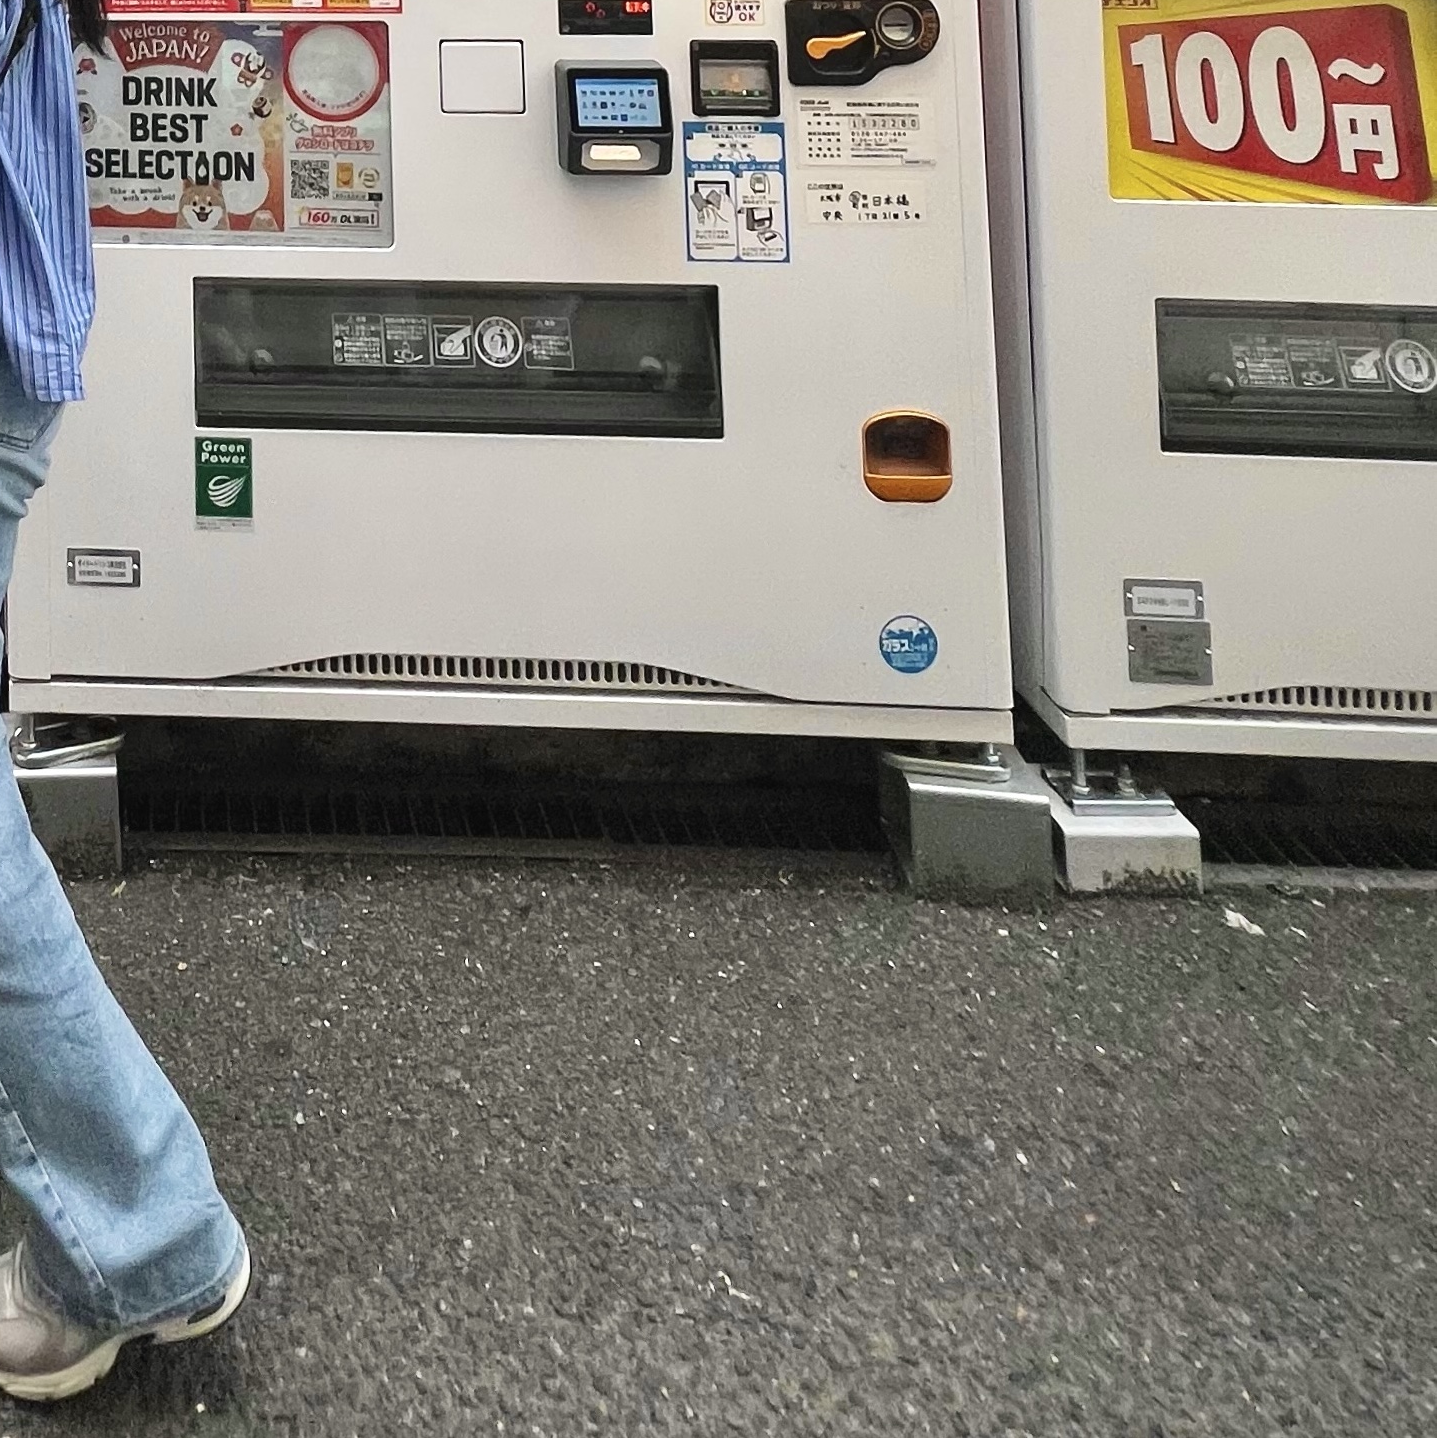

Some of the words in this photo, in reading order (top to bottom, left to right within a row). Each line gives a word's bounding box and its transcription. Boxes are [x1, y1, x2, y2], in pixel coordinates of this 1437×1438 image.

[738, 13, 756, 22] OK
[118, 23, 188, 42] Welcome
[192, 26, 211, 42] to
[124, 38, 210, 64] JAPAN!
[122, 75, 218, 108] DRINK
[129, 112, 209, 144] BEST
[202, 440, 245, 453] Green
[201, 451, 247, 464] Power
